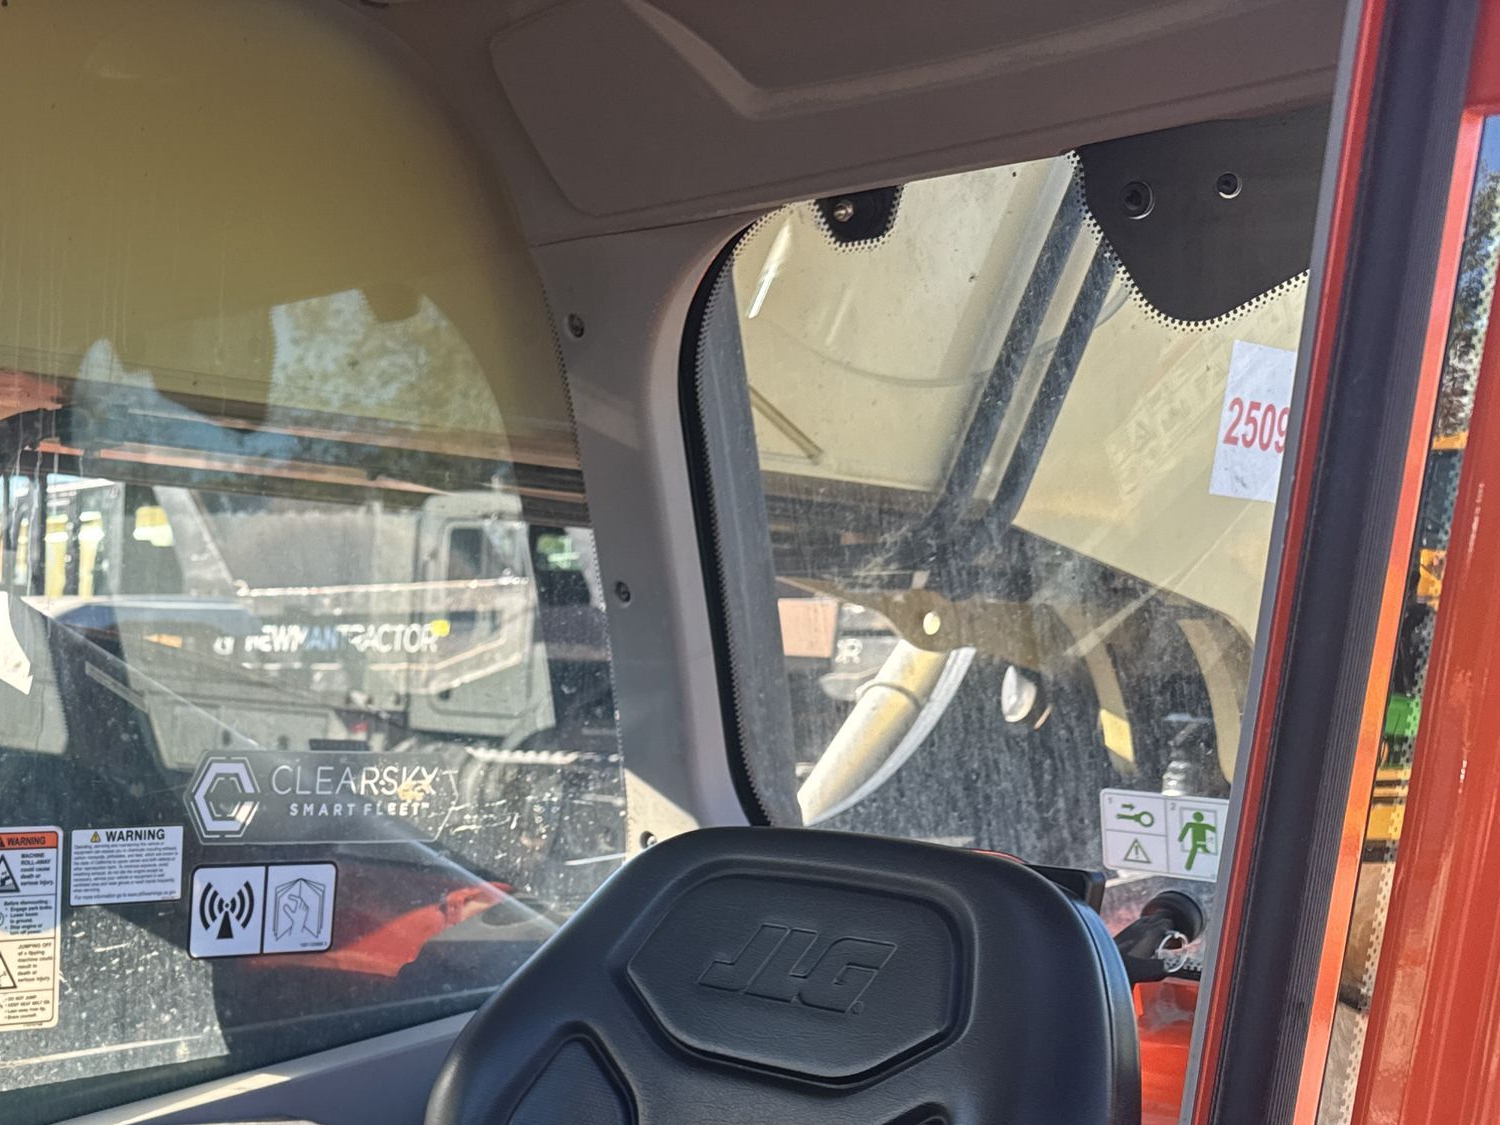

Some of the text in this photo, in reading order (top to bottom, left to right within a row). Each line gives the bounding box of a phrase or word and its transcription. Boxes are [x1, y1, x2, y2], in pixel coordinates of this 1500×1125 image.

[290, 803, 357, 816] SMART
[106, 829, 165, 841] WARNING
[7, 837, 45, 846] WARNING
[698, 923, 898, 1014] JLG
